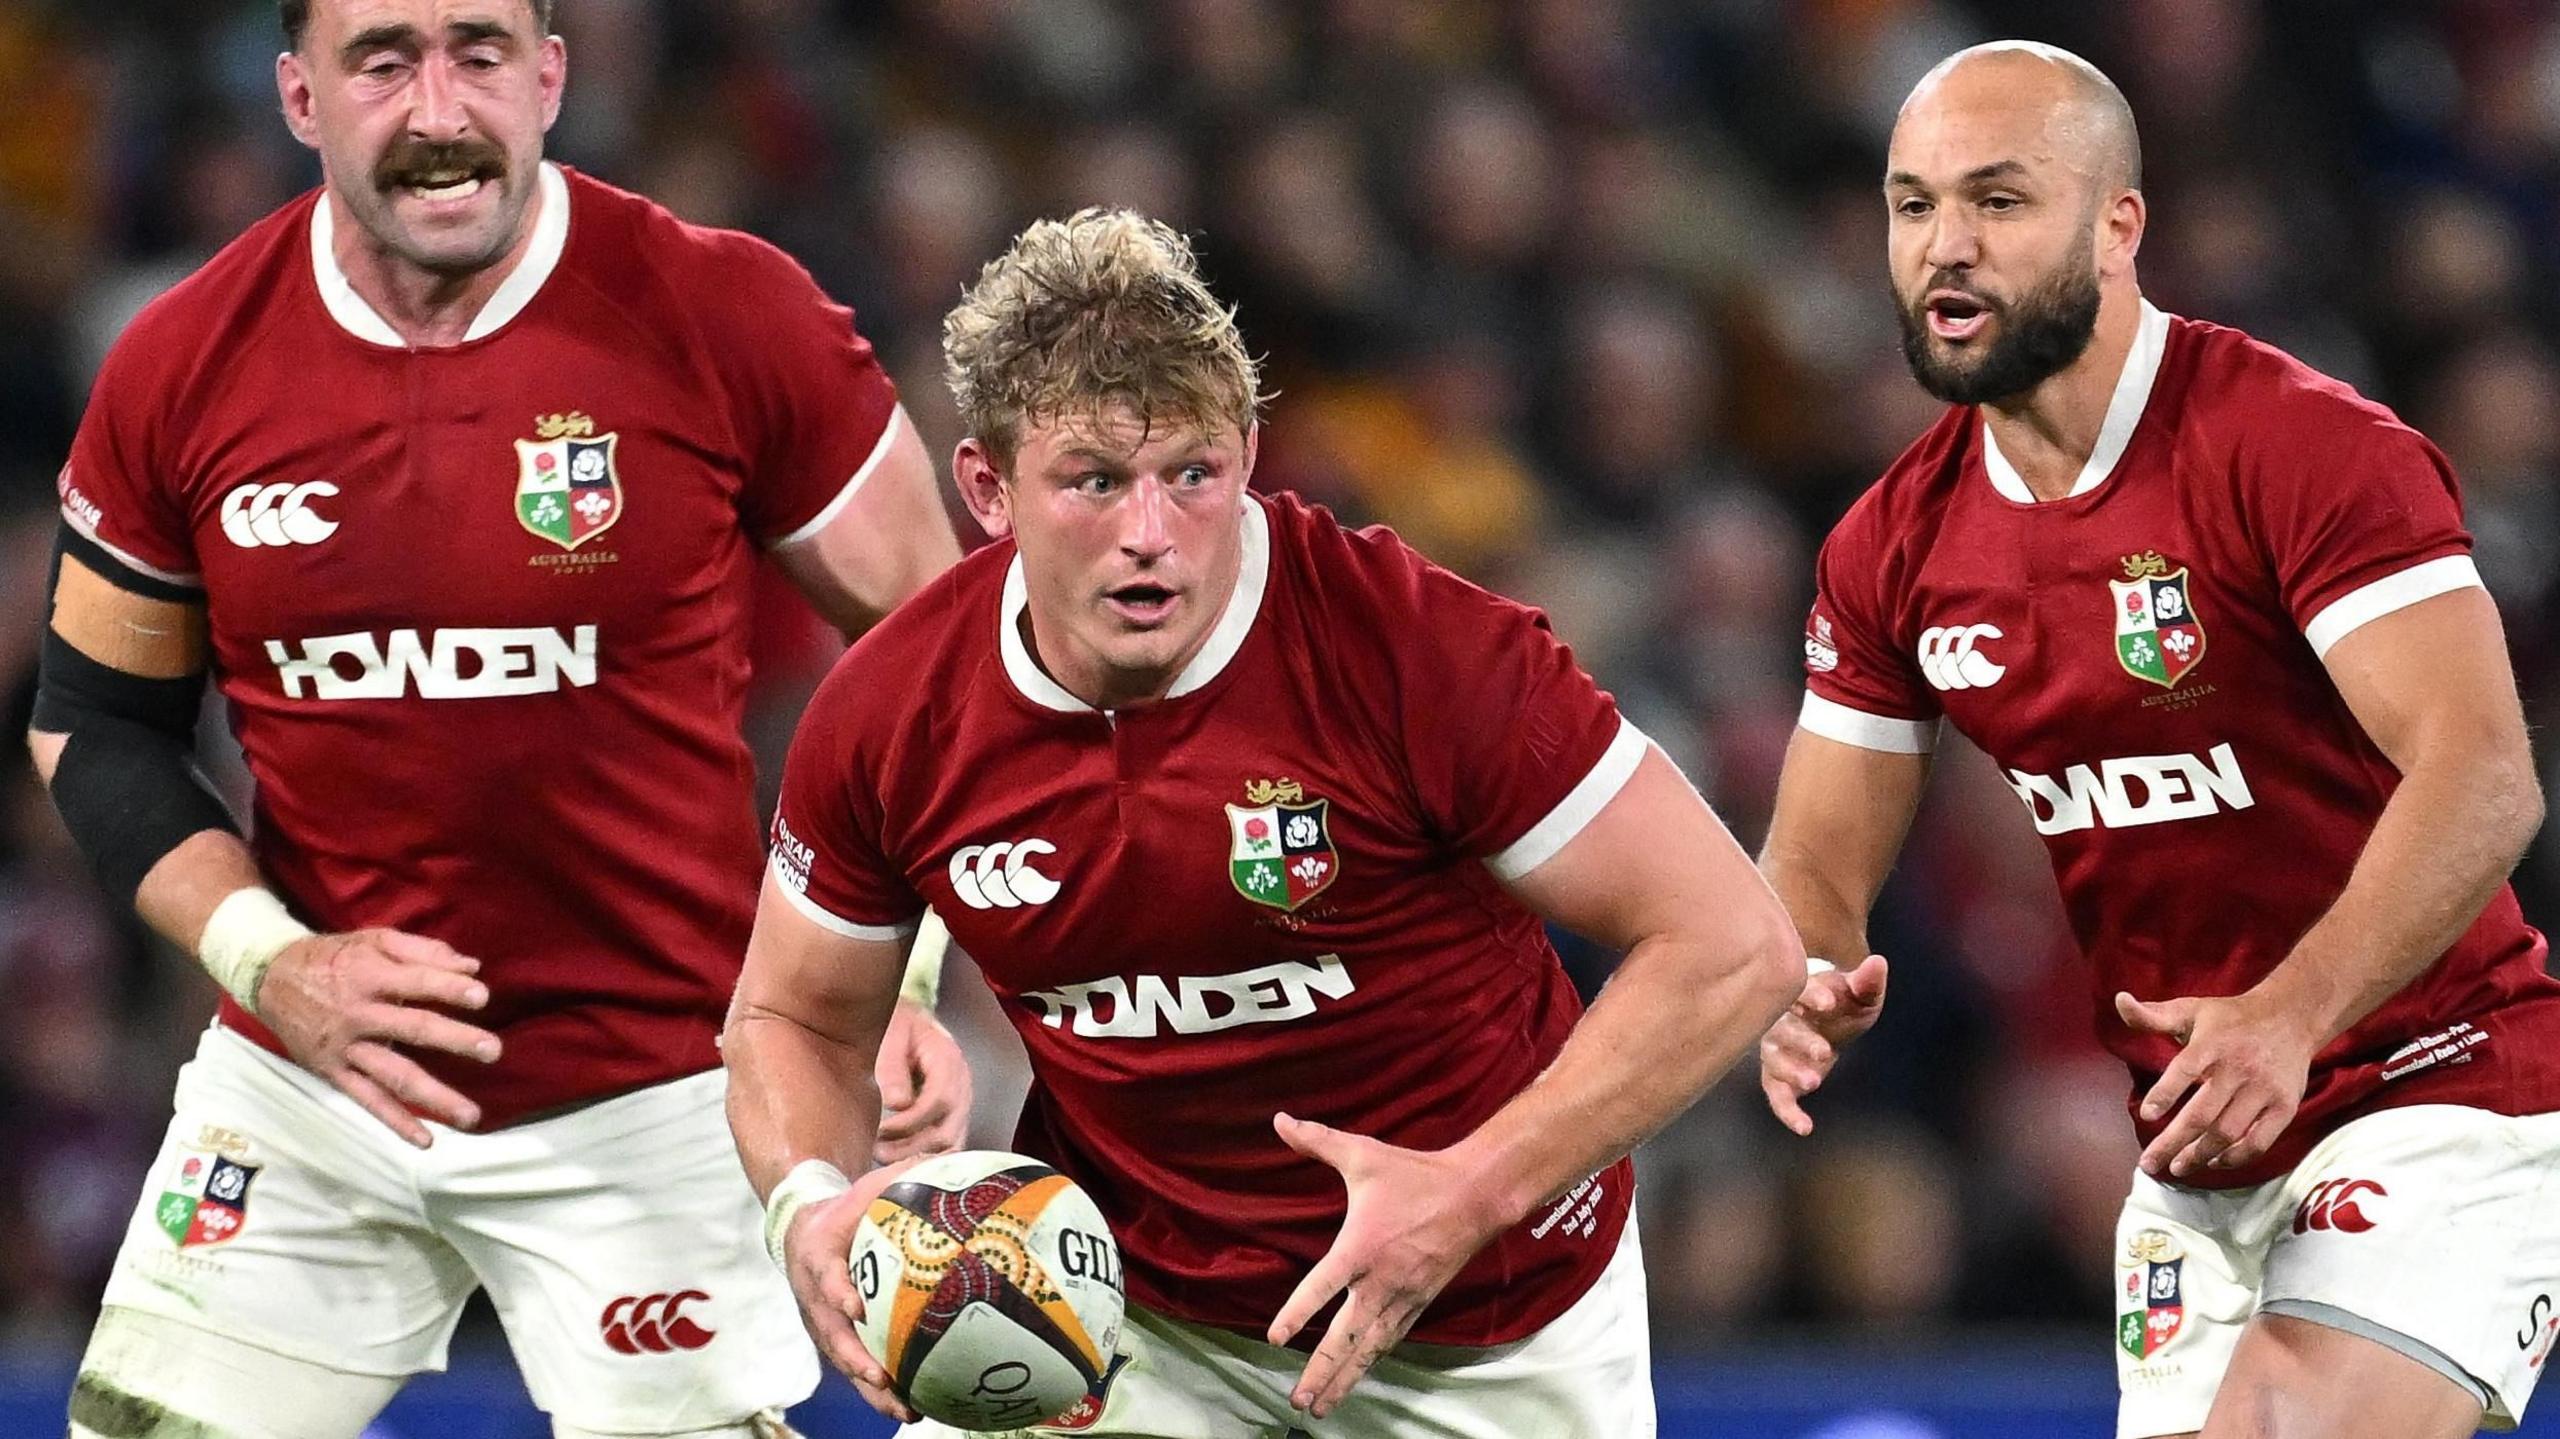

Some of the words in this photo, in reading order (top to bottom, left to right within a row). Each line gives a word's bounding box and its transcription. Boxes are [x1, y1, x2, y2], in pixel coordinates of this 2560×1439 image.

[528, 553, 619, 566] AUSTRALIA
[264, 624, 597, 700] HOWDEN
[2141, 684, 2216, 708] AUSTRALIA
[2000, 742, 2255, 836] OWDEN
[1531, 1194, 1575, 1239] Queensland
[1562, 1215, 1579, 1236] 2nd
[1576, 1203, 1592, 1223] July
